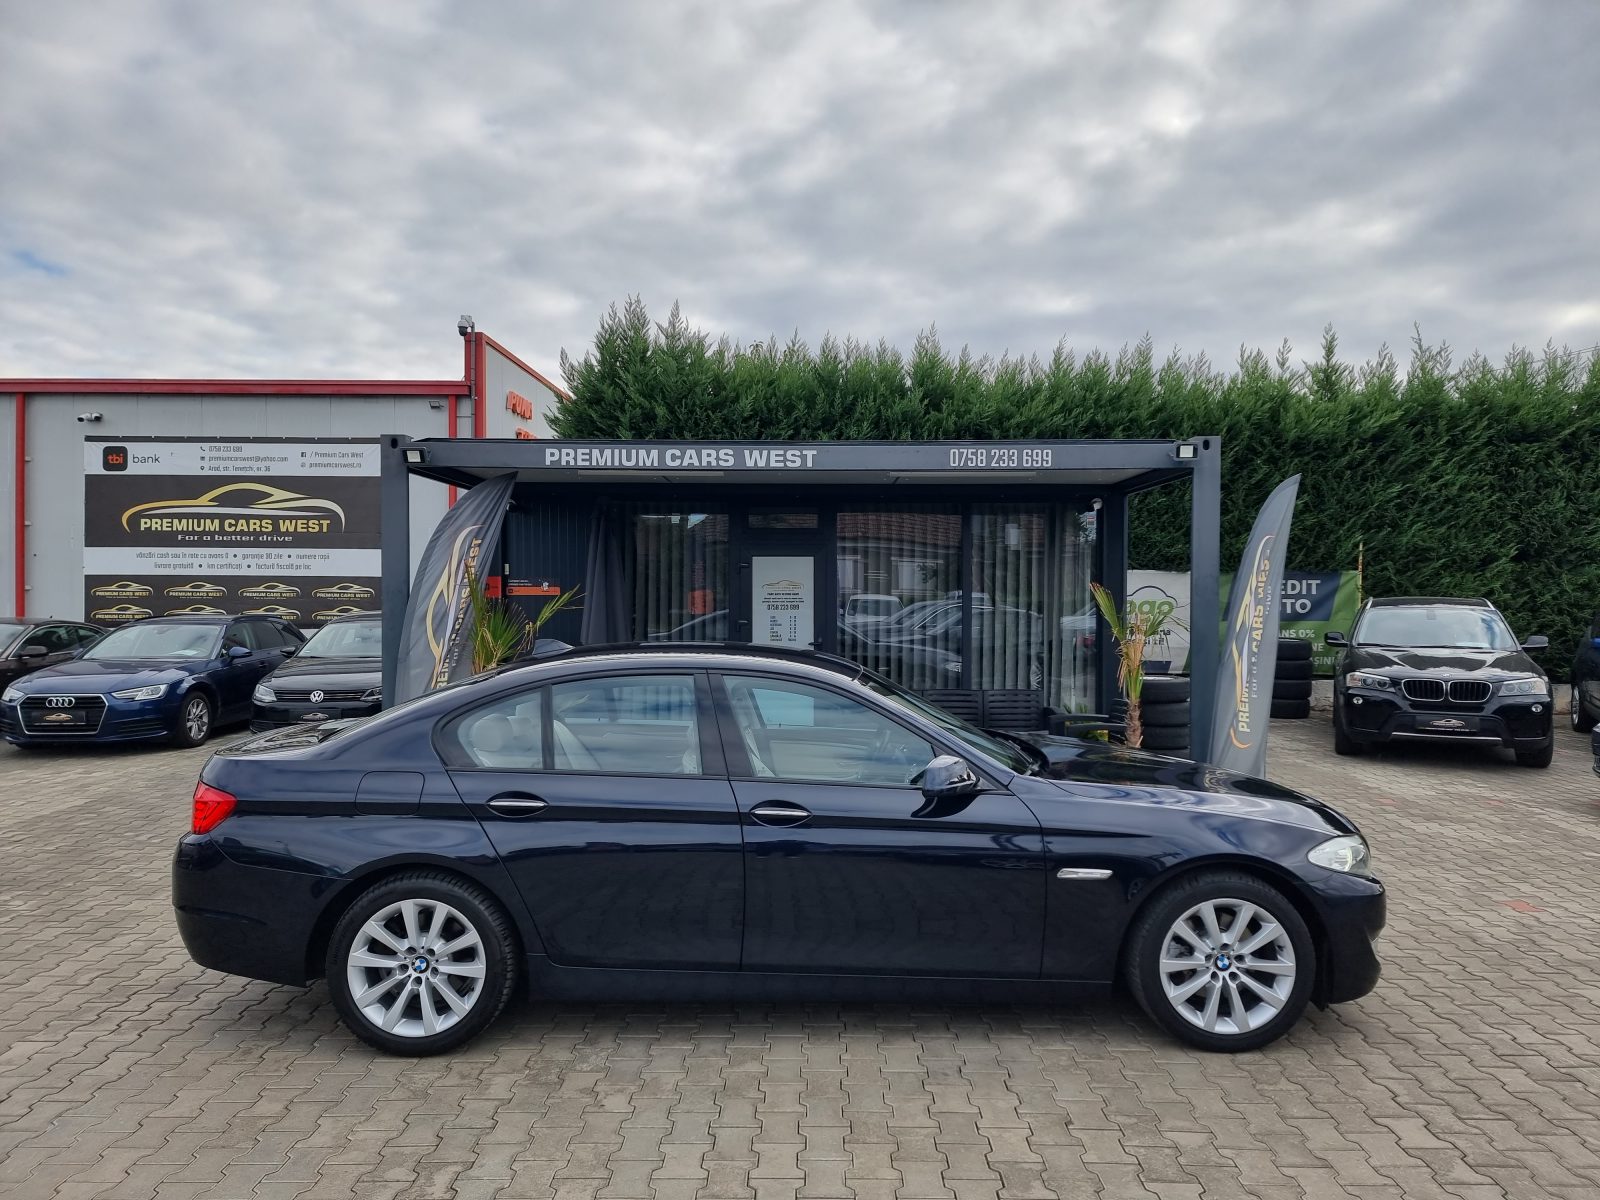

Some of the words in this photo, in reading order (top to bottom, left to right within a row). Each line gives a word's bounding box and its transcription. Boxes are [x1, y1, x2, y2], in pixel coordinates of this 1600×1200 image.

[107, 453, 124, 464] tbi
[132, 453, 160, 464] bank
[545, 448, 659, 466] PREMIUM
[665, 448, 735, 467] CARS
[743, 449, 817, 468] WEST
[950, 449, 986, 467] 0758
[991, 449, 1018, 467] 233
[1022, 449, 1052, 467] 699
[140, 518, 220, 531] PREMIUM
[224, 518, 273, 532] CARS
[279, 519, 331, 533] WEST
[259, 534, 293, 542] drive
[1281, 579, 1321, 595] EDIT
[1281, 598, 1312, 614] TO
[1299, 629, 1316, 638] 0%
